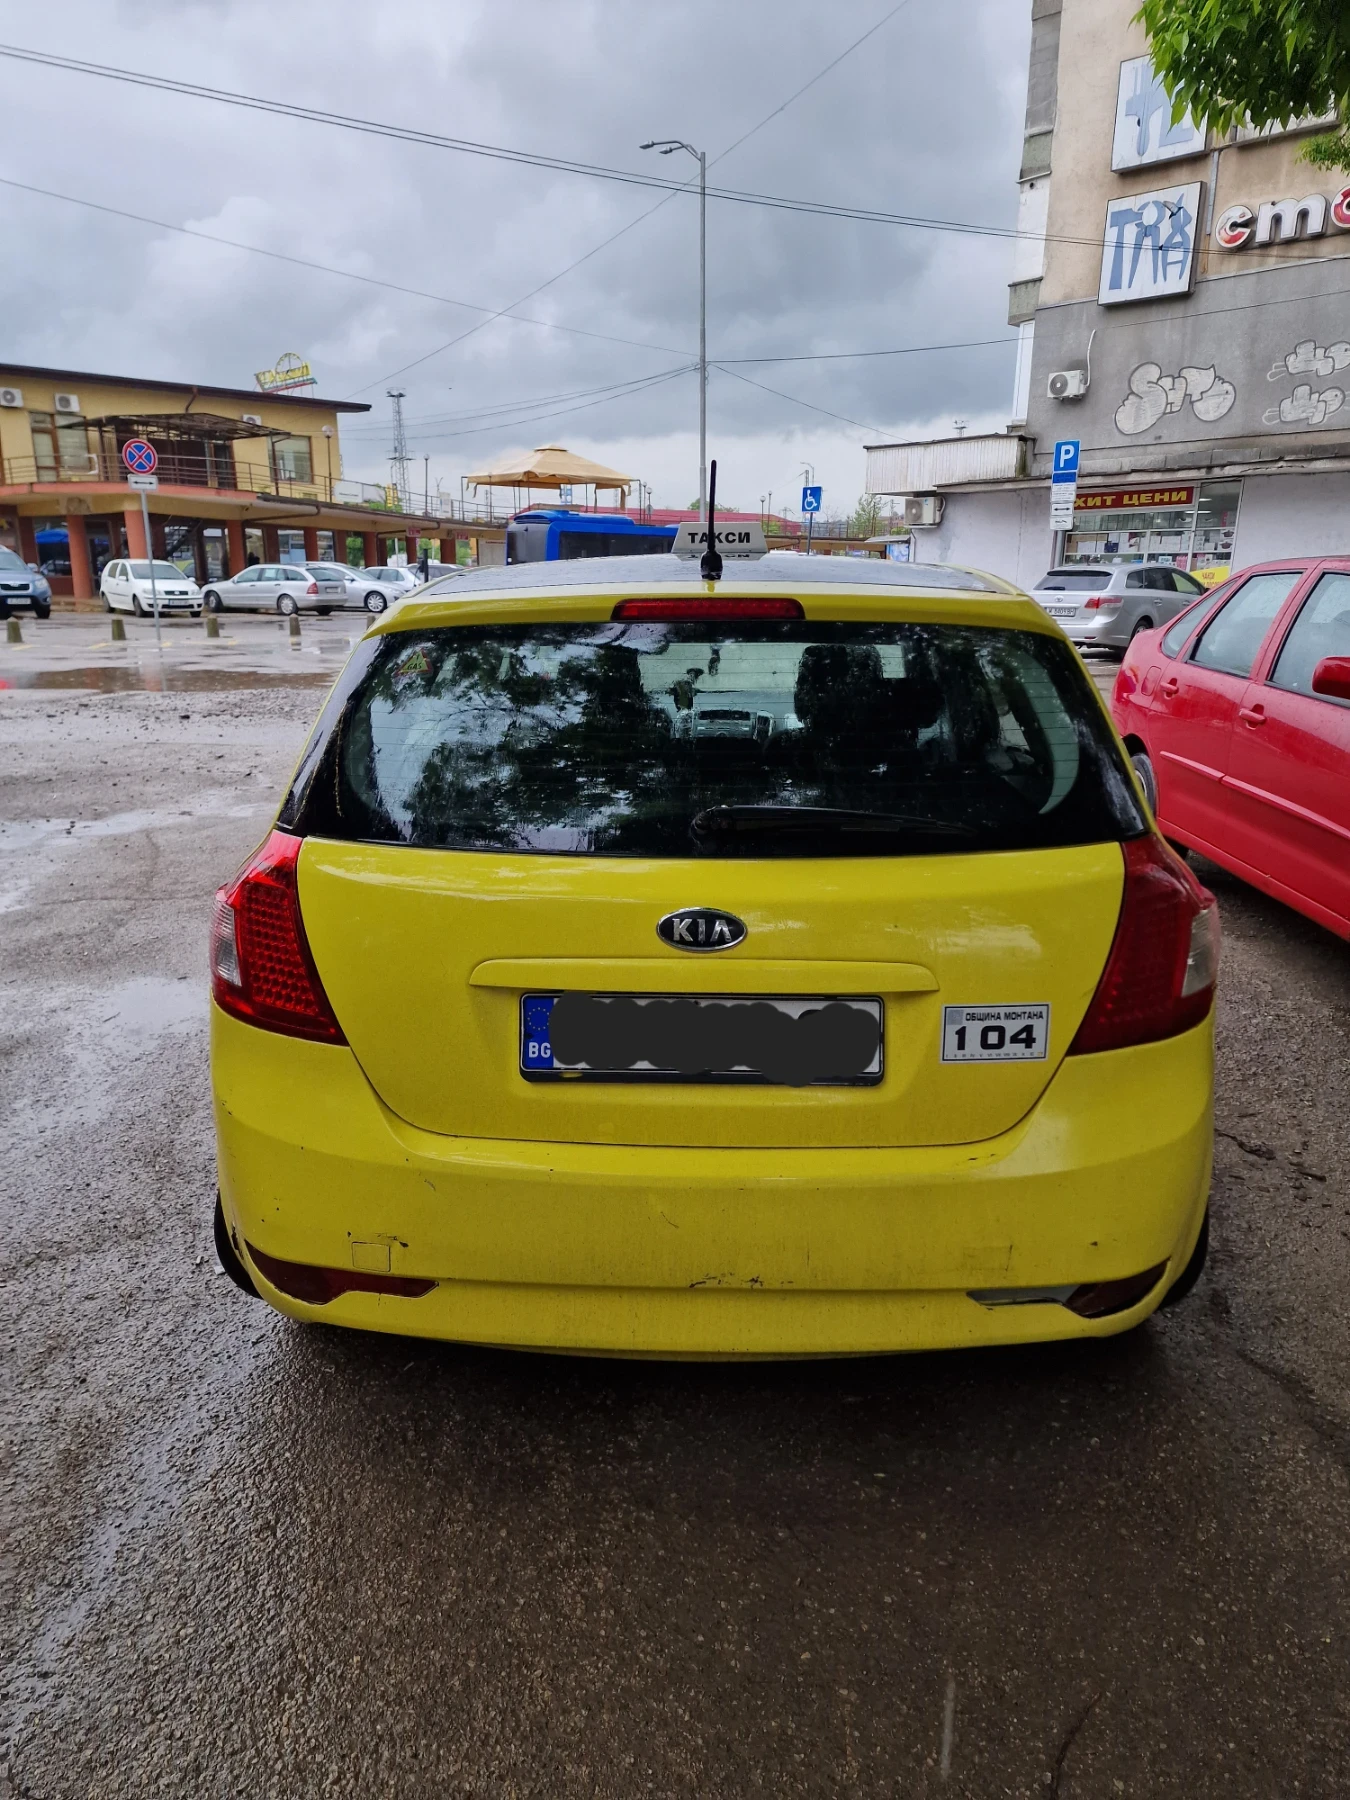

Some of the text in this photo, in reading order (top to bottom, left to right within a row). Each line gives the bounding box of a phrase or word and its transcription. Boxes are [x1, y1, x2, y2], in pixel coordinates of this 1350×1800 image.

[1060, 445, 1075, 468] P
[1074, 495, 1116, 507] ХИТ
[1123, 491, 1187, 505] ЦЕНИ
[688, 532, 751, 544] ТАКСИ
[407, 662, 422, 670] GAS
[672, 919, 732, 942] KIA
[965, 1010, 1044, 1022] ОБЩИНА МОНТАНА
[528, 1042, 551, 1058] BG
